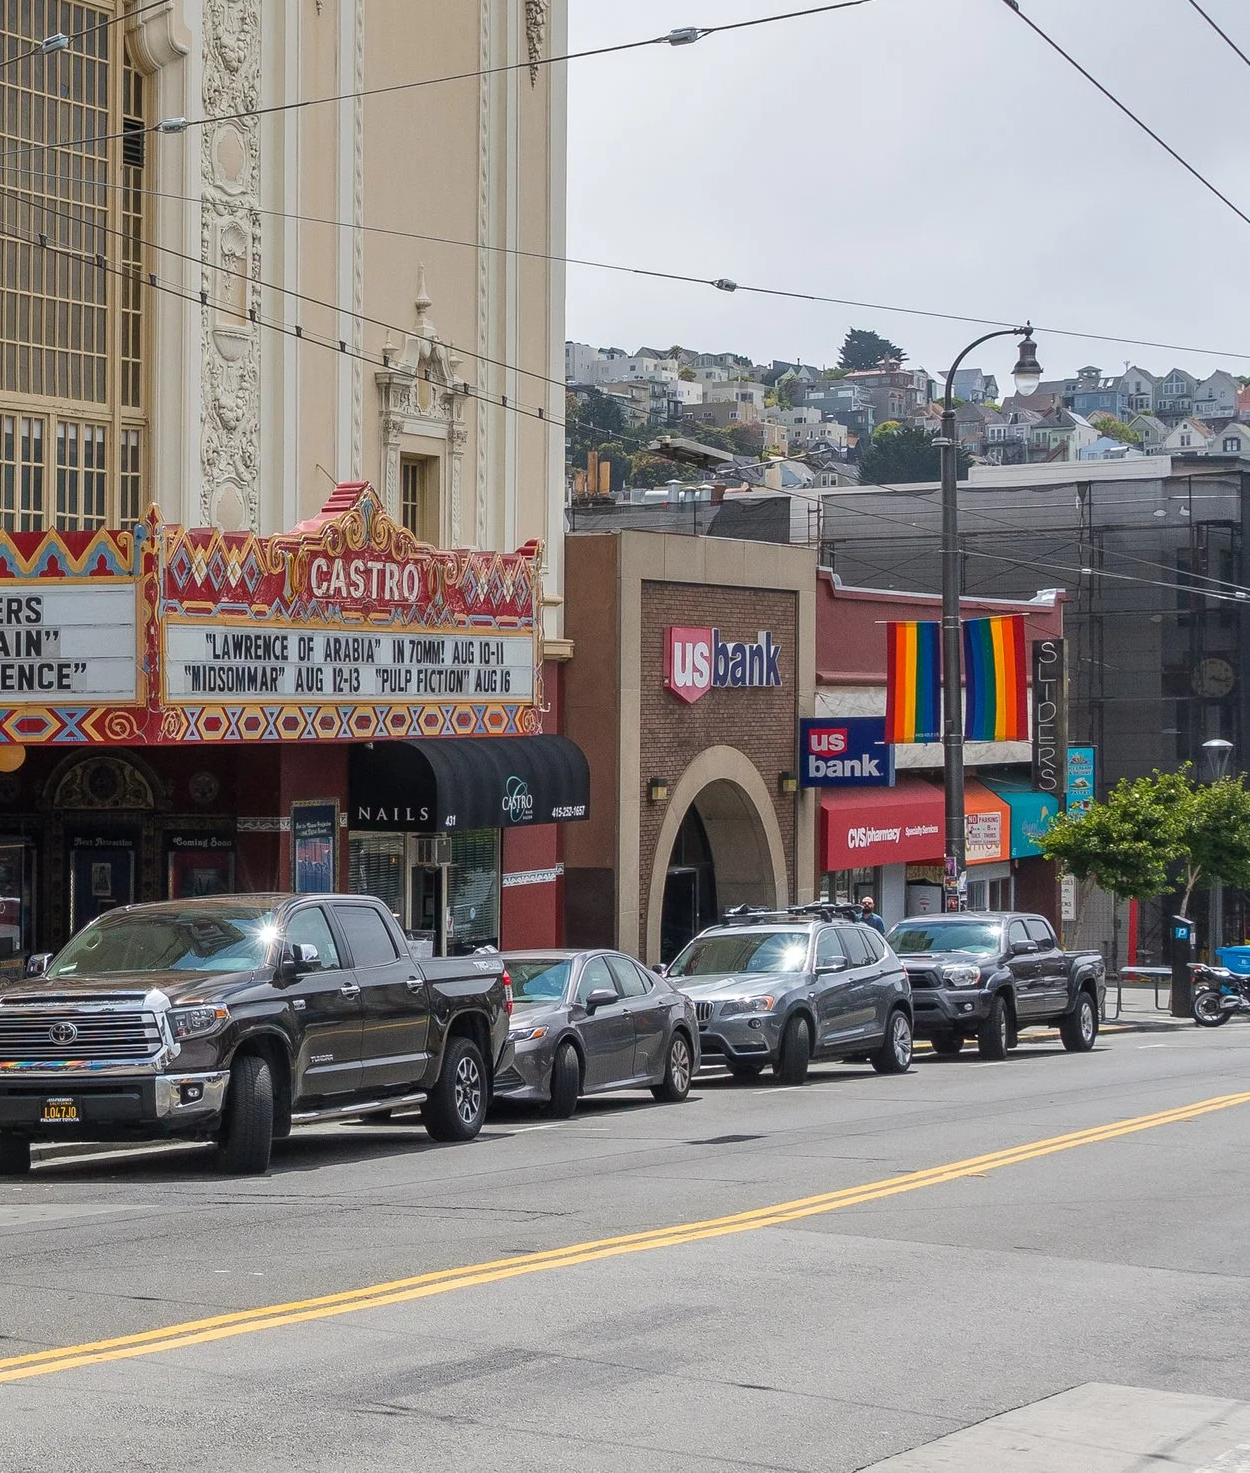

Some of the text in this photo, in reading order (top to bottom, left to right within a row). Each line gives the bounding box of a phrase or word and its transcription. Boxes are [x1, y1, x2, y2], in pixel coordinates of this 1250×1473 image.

[310, 557, 420, 603] CASTRO
[205, 633, 505, 665] "LAWRENCE OF ARABIA" IN 70MM! AUG 10-11
[673, 627, 782, 688] us bank
[184, 665, 511, 693] "MIDSOMMAR" AUG 12-13 "PULP FICTION" AUG 16
[1038, 641, 1057, 791] SLIDERS
[808, 732, 881, 777] us bank
[358, 807, 430, 821] NAILS
[501, 794, 533, 812] CASTRO
[445, 815, 457, 827] 431
[968, 815, 999, 824] NO PARKING
[172, 836, 233, 848] Coming Soon
[847, 826, 902, 849] CVS/pharmacy
[1178, 928, 1187, 937] P
